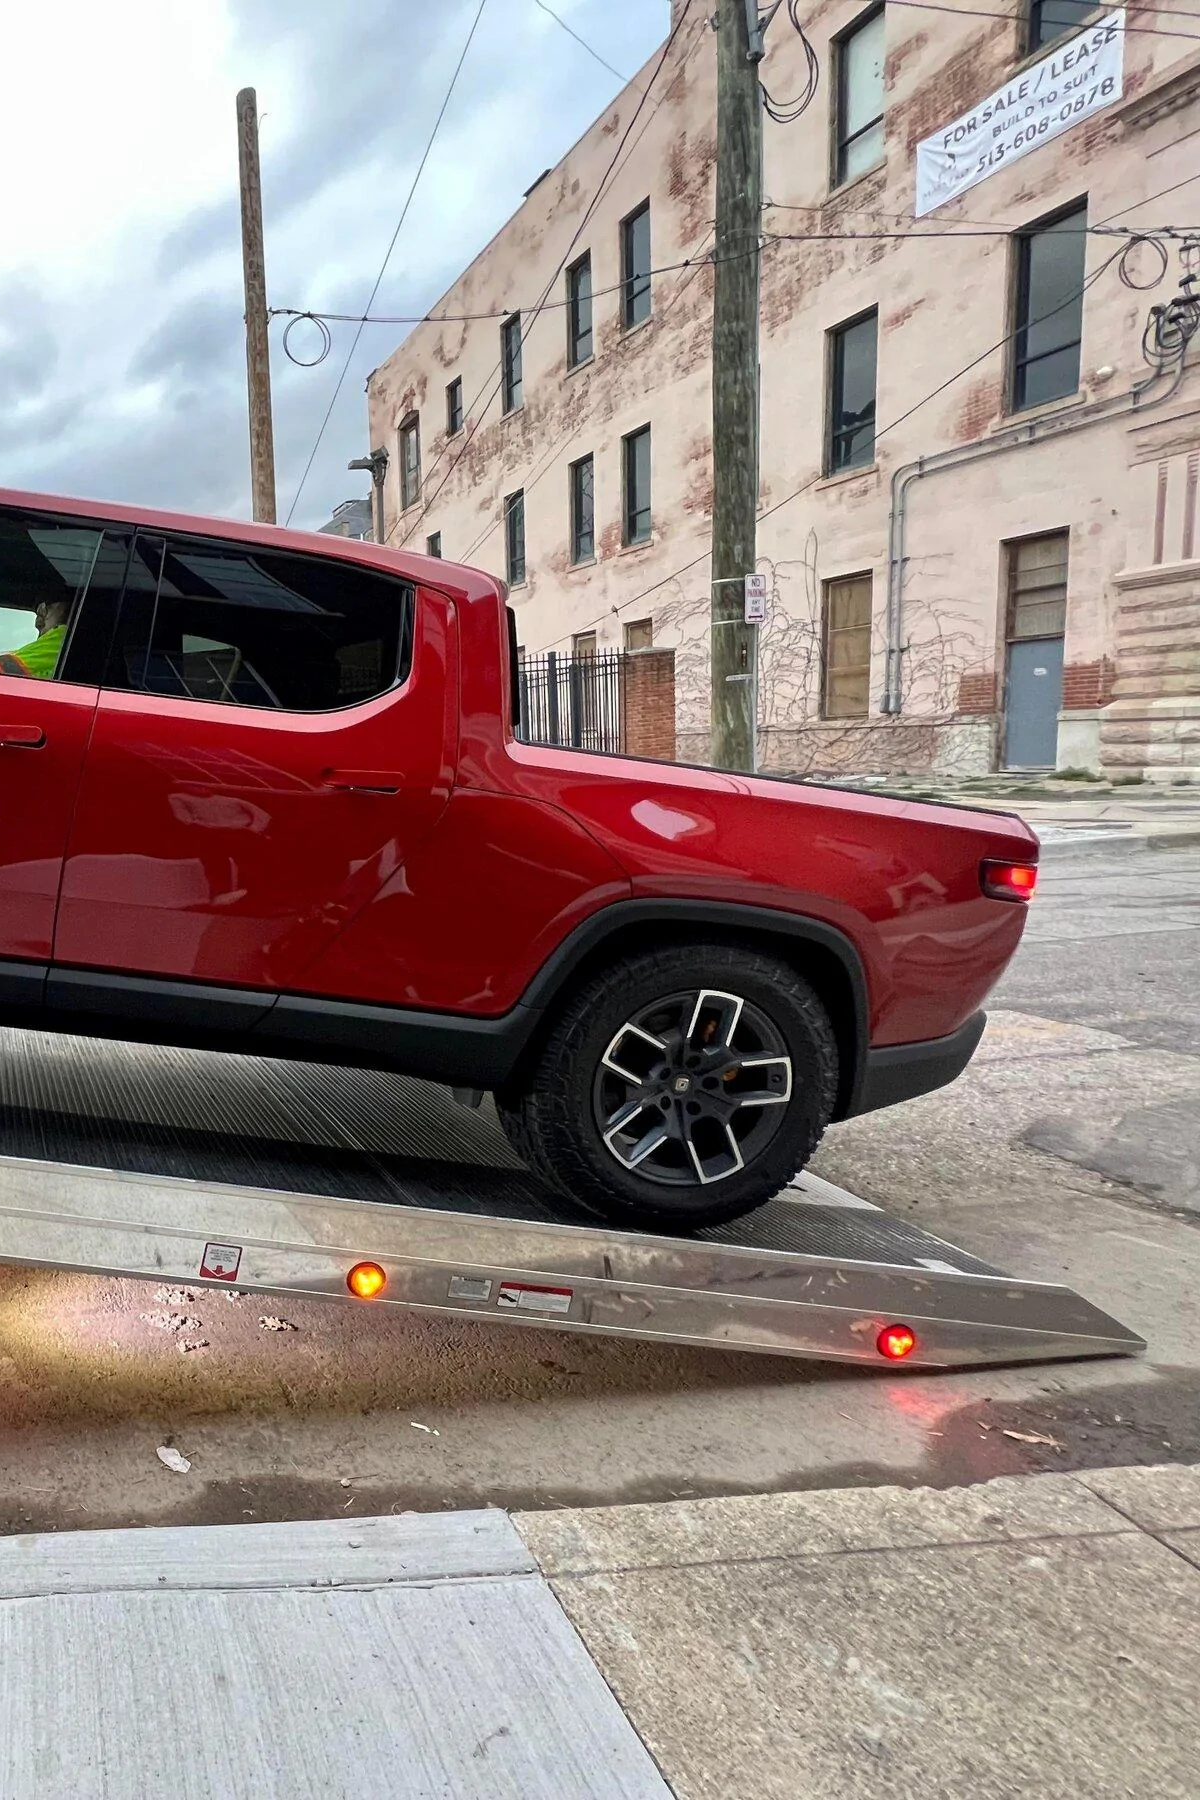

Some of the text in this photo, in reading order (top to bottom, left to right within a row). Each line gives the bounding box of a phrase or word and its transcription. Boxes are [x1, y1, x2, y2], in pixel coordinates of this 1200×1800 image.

[944, 116, 978, 149] FOR
[982, 80, 1030, 124] SALE
[1051, 19, 1119, 80] LEASE
[976, 76, 1115, 173] 513-608-0878
[992, 63, 1099, 138] BUILD TO SUIT
[751, 578, 761, 588] NO
